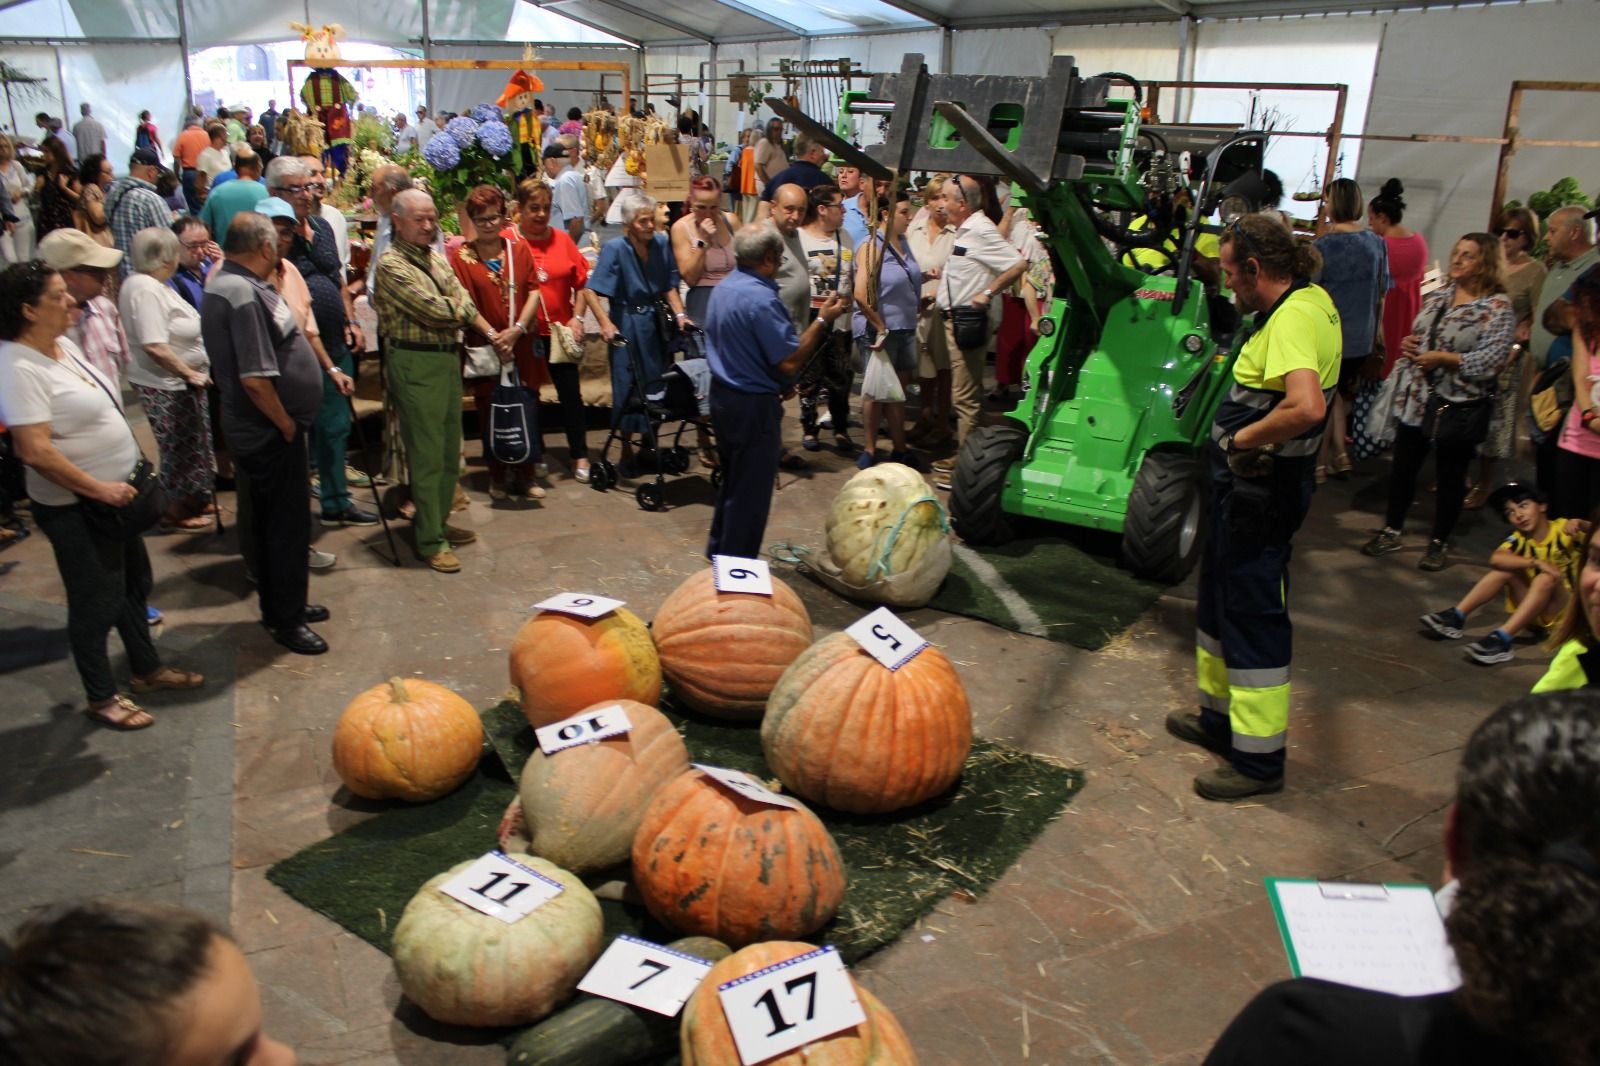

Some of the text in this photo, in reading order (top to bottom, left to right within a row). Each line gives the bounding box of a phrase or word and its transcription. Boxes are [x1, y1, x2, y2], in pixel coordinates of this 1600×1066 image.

[872, 624, 902, 651] 5
[557, 715, 609, 740] 10
[468, 871, 531, 907] 11
[628, 959, 671, 990] 7
[753, 971, 817, 1038] 17
